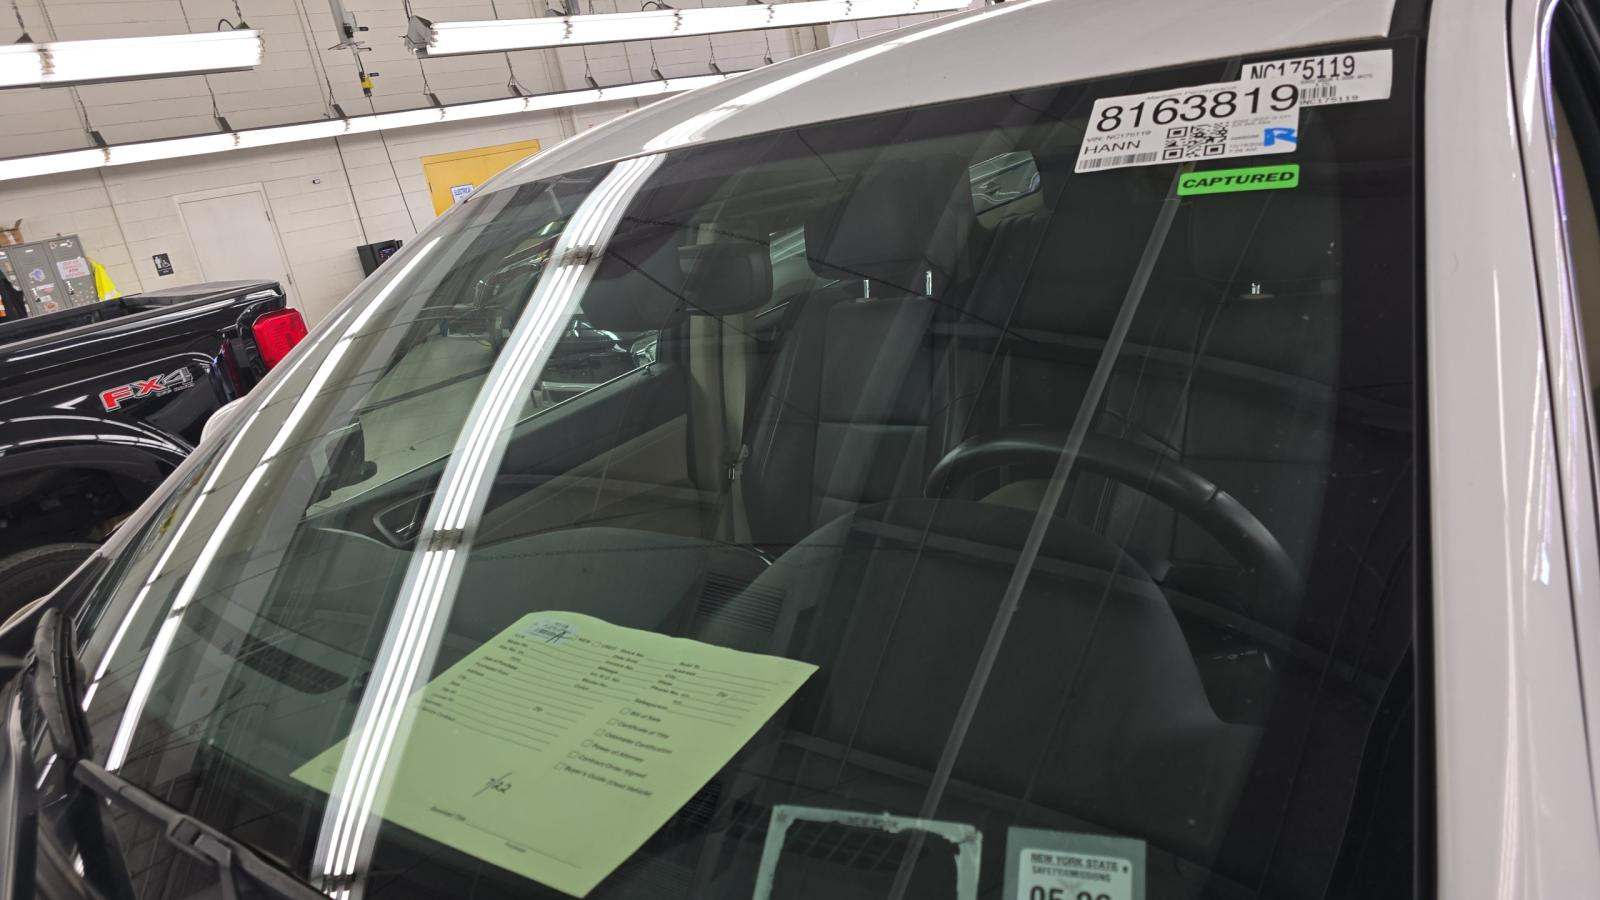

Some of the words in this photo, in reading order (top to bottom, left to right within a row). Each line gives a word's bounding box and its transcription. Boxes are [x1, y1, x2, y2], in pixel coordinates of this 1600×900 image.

[1250, 55, 1355, 79] NC175119
[1097, 84, 1299, 132] 8163819
[1084, 140, 1141, 155] HANN
[1182, 170, 1295, 190] CAPTURED
[99, 366, 194, 412] FX4
[1031, 853, 1052, 863] NEW
[1057, 857, 1082, 867] YORK
[1086, 860, 1117, 872] STATE
